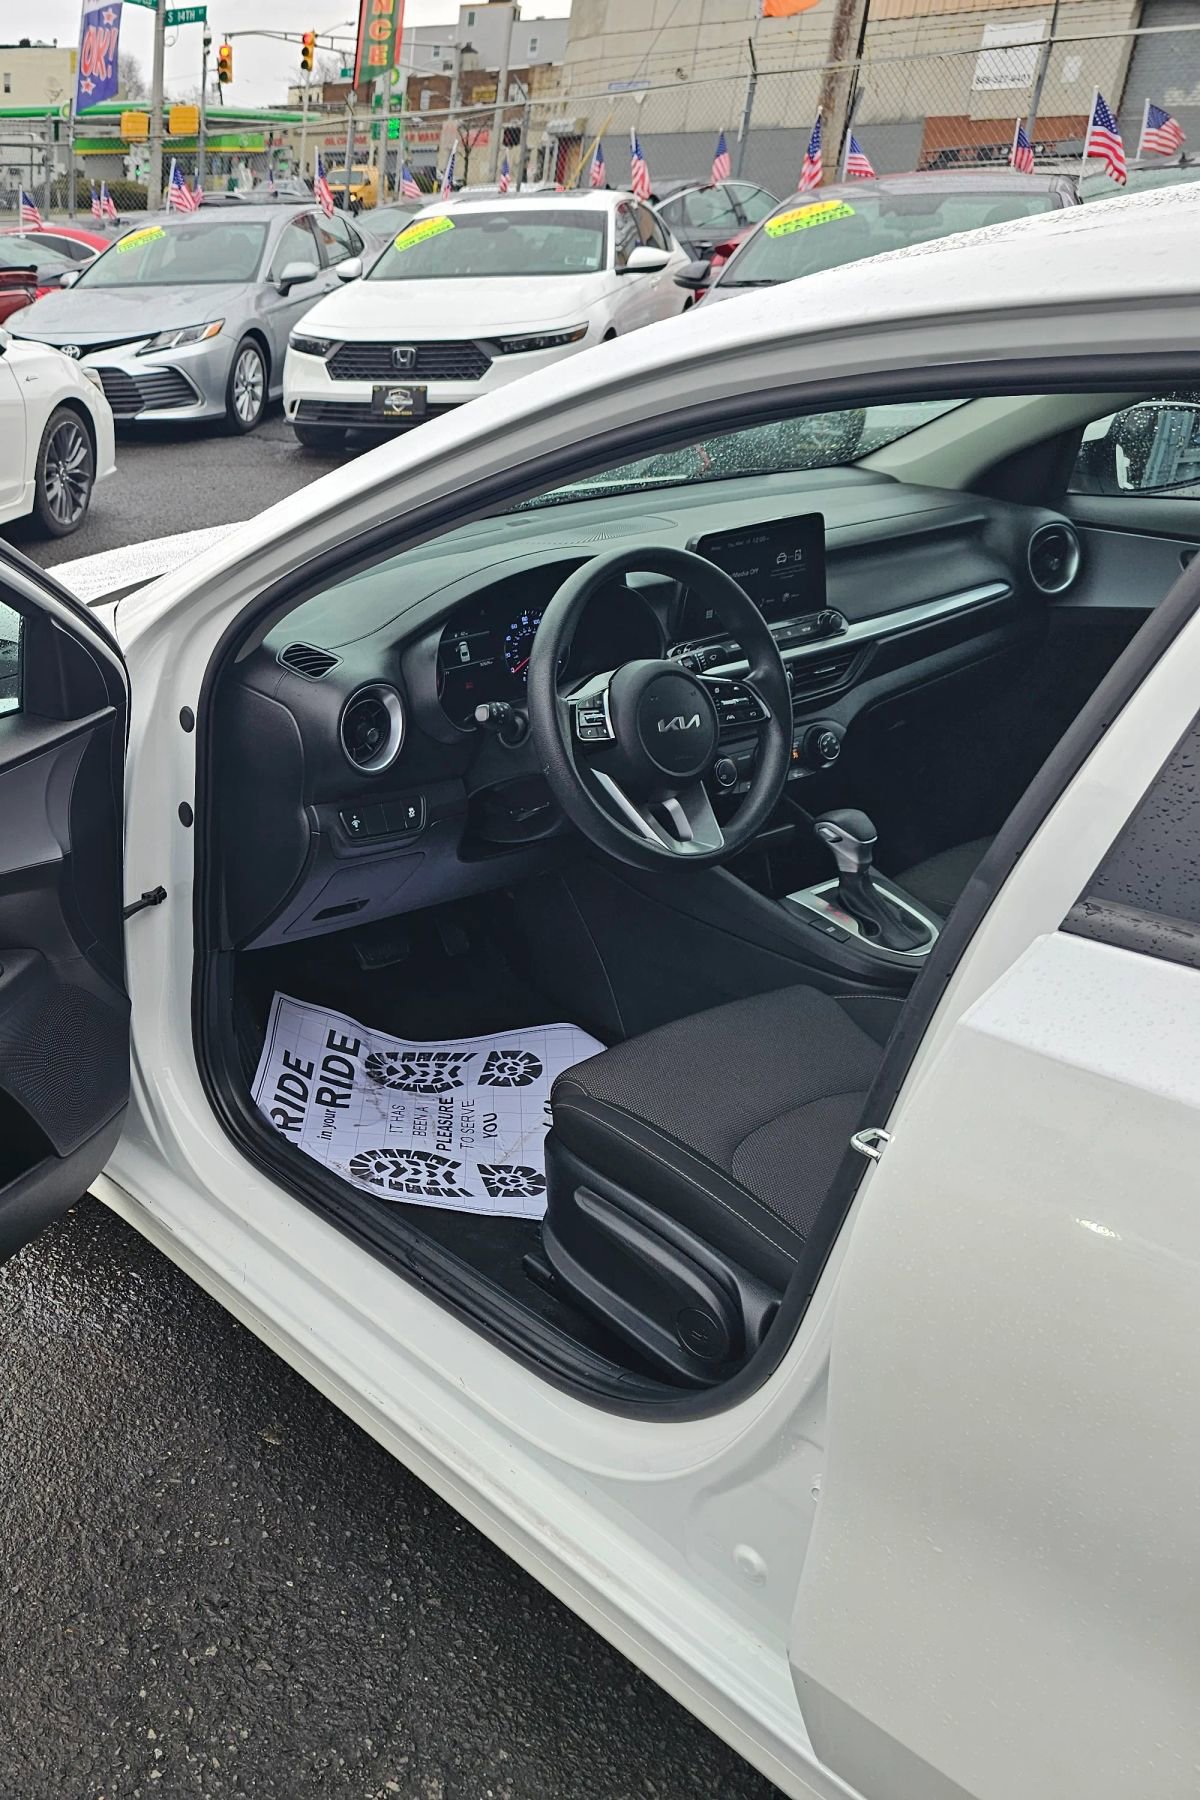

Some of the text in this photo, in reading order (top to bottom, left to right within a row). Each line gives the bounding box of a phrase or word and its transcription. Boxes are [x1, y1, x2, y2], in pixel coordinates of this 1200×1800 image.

[167, 13, 174, 23] S
[177, 10, 196, 21] 14TH
[81, 26, 118, 81] OK!
[269, 1049, 315, 1146] RIDE
[315, 1028, 361, 1141] in your RIDE
[389, 1104, 406, 1134] IT HAS
[412, 1114, 428, 1137] BEEN
[435, 1096, 454, 1152] PLEASURE
[459, 1099, 475, 1149] TO SERVE
[482, 1112, 498, 1139] YOU
